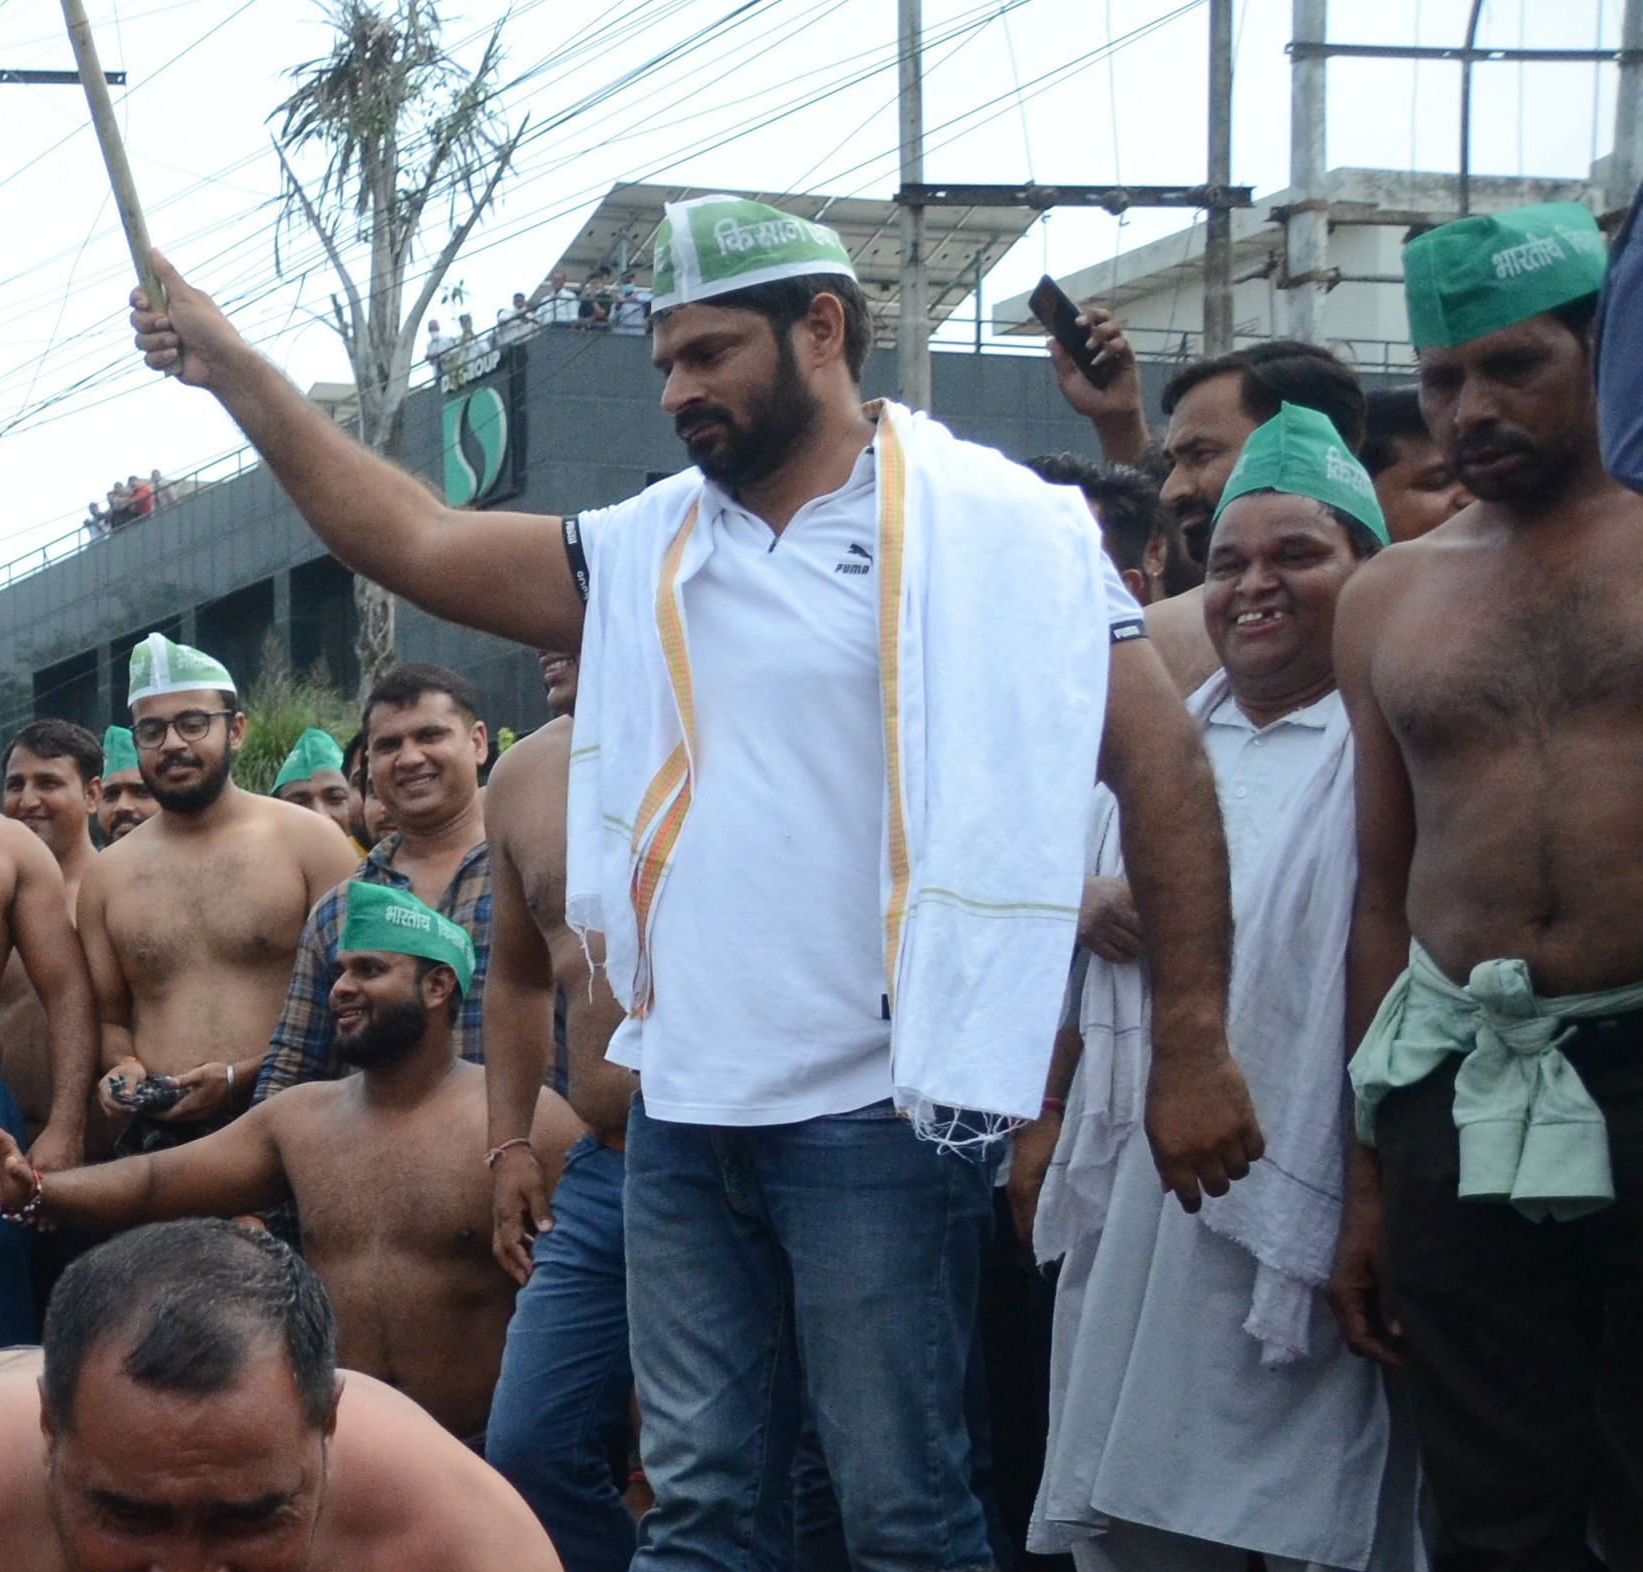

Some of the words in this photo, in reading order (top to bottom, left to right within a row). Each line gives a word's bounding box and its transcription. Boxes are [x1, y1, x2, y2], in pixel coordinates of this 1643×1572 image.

[713, 217, 806, 256] किसान
[1491, 231, 1565, 279] भारतीय
[834, 563, 870, 575] PUMA
[385, 905, 432, 932] भारतीय
